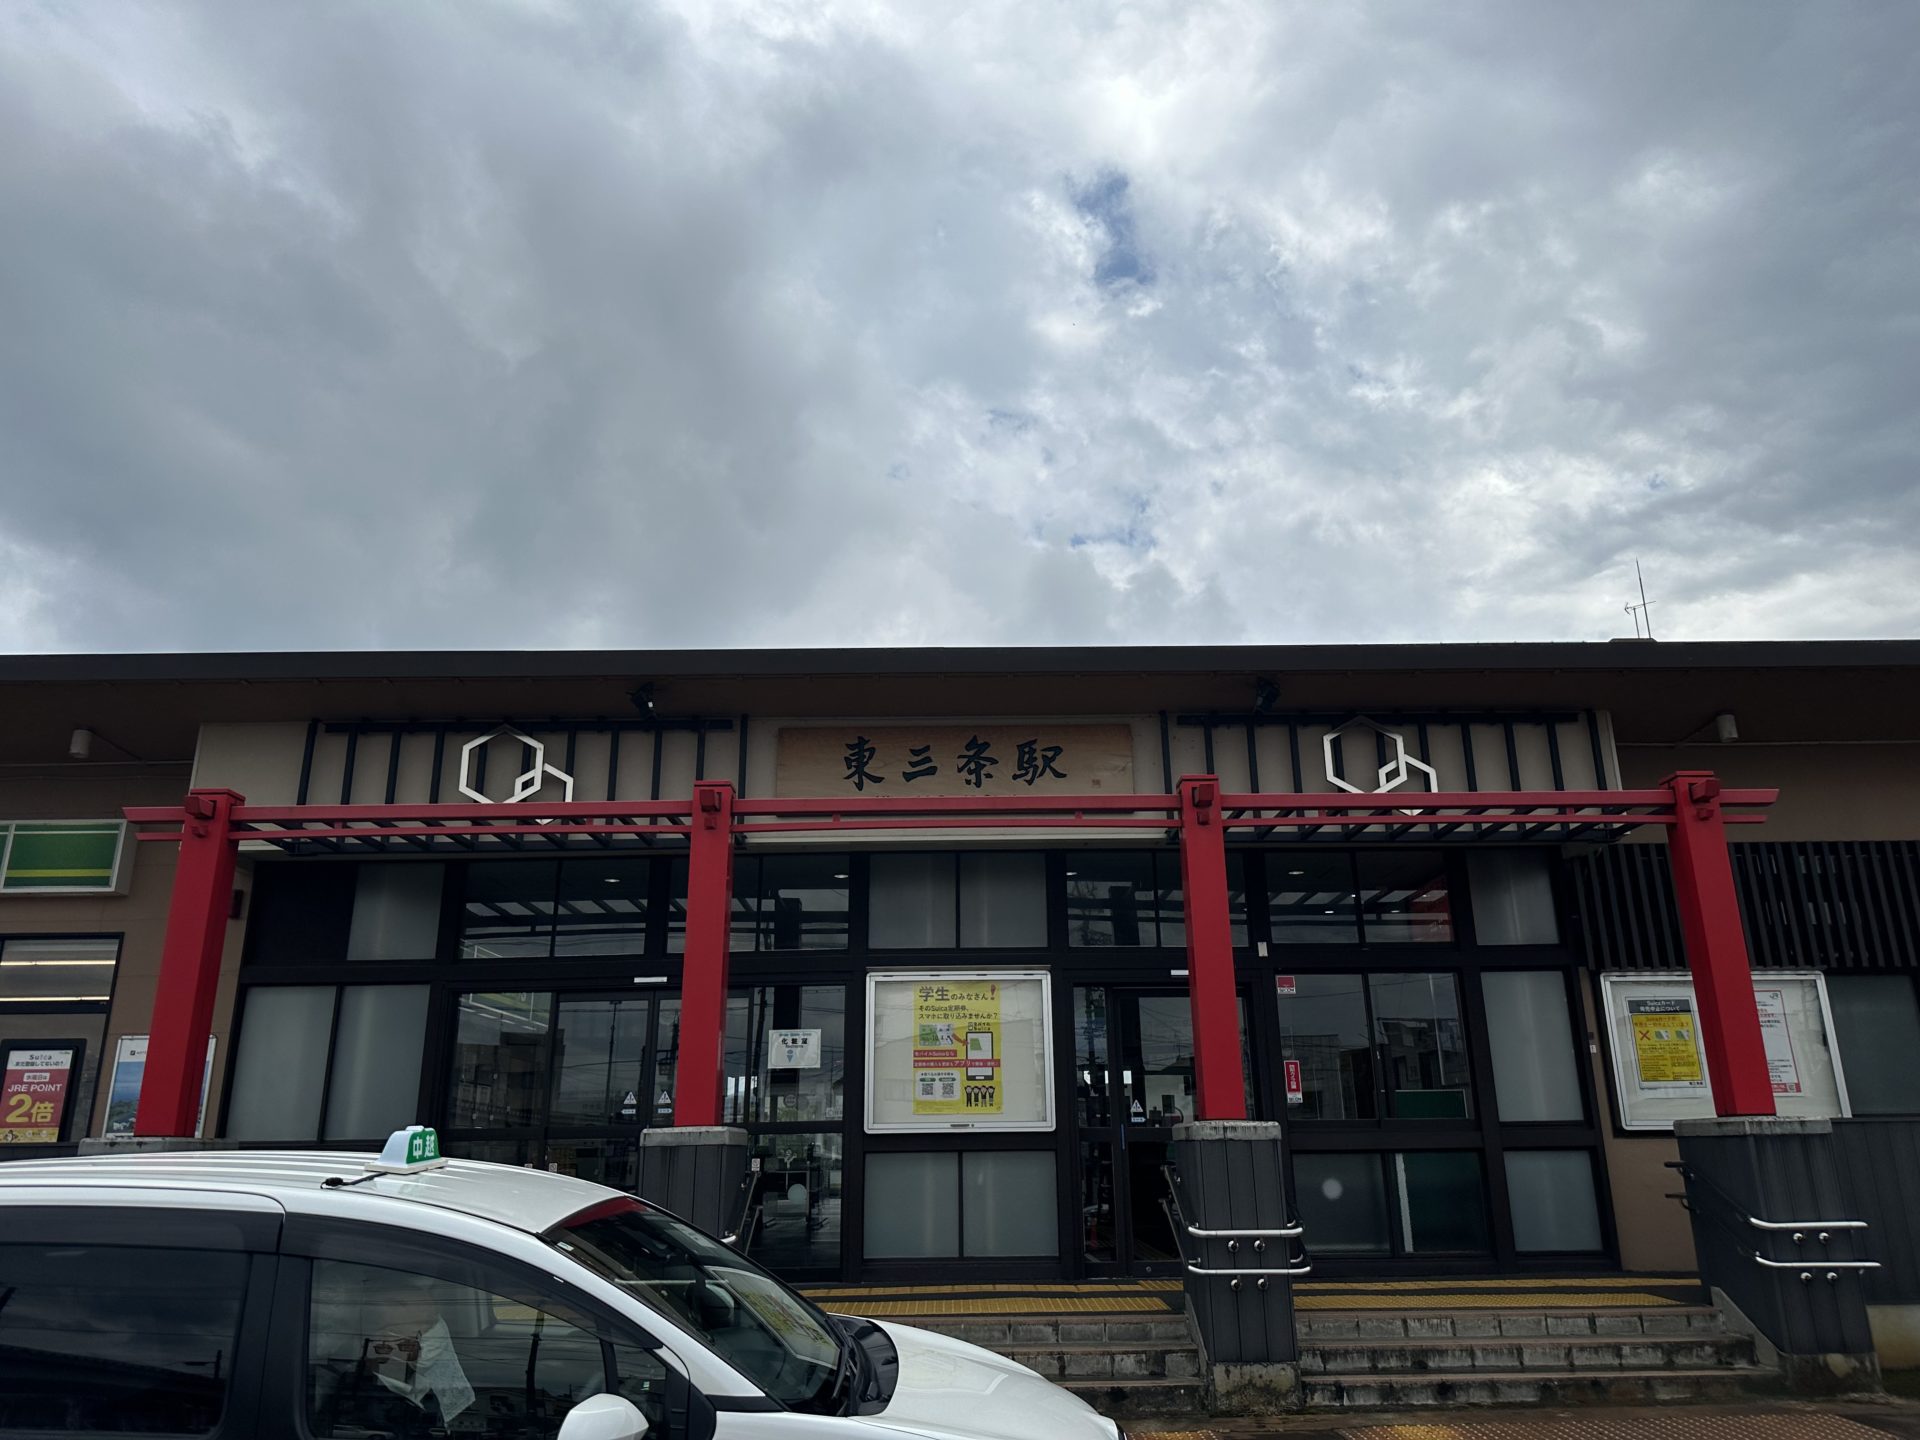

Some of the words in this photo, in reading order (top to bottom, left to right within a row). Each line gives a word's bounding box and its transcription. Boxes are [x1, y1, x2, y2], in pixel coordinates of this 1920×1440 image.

[843, 735, 1067, 791] 東三条駅
[8, 1083, 29, 1092] JRE
[30, 1083, 63, 1092] POINT
[6, 1093, 55, 1123] 2倍
[412, 1134, 435, 1160] 中越
